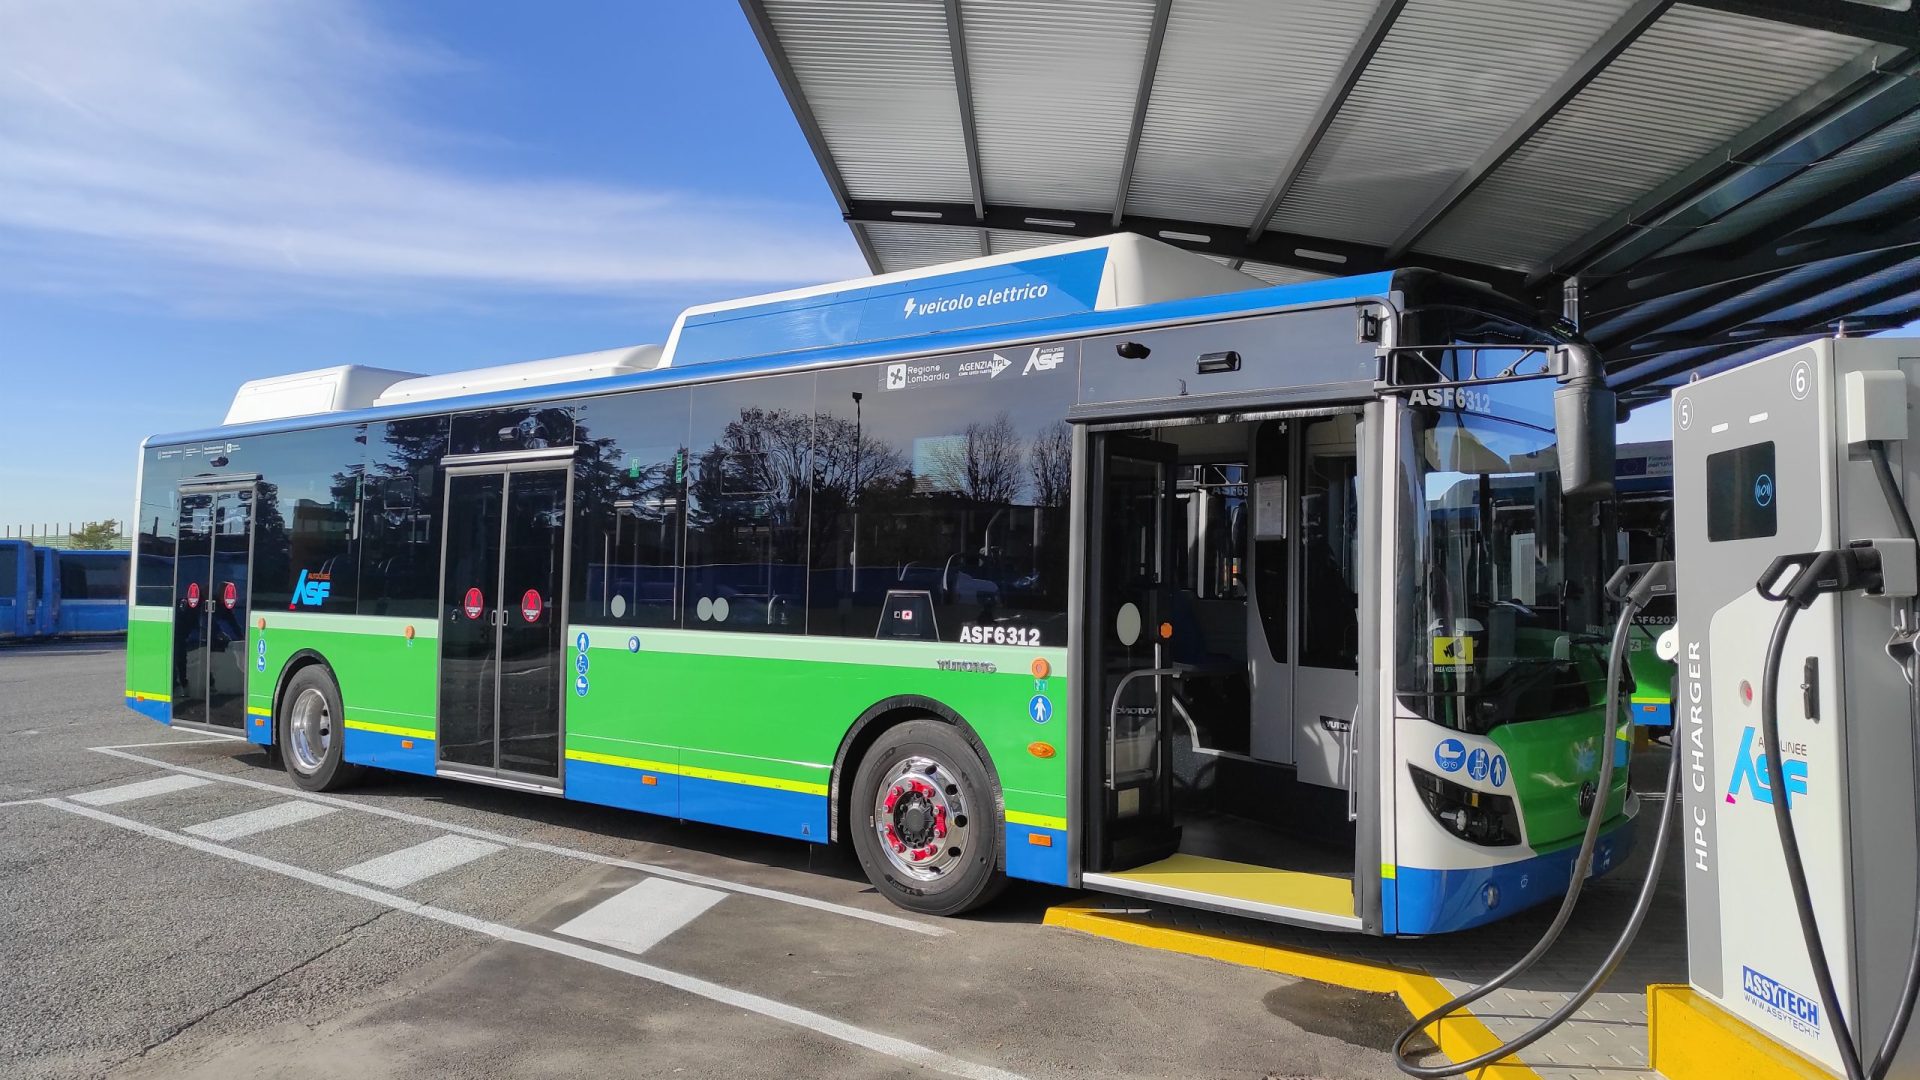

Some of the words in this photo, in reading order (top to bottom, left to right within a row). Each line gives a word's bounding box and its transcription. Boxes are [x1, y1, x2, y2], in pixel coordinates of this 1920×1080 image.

[919, 293, 974, 316] veicolo
[977, 283, 1048, 307] elettrico
[907, 364, 941, 375] Regione
[1021, 347, 1065, 376] ASF
[907, 371, 950, 384] Lombardia
[1796, 368, 1806, 393] 6
[1408, 387, 1491, 413] ASF6312
[1682, 404, 1689, 425] 5
[289, 568, 331, 609] ASF
[959, 625, 1041, 647] ASF6312
[936, 659, 998, 675] YUTONG
[1325, 719, 1351, 730] YUTON
[1688, 641, 1706, 793] CHARGER
[1757, 736, 1808, 757] ALINEE
[1693, 805, 1708, 872] HPC
[1744, 968, 1820, 1027] ASSYTECH
[1743, 993, 1821, 1041] WWW.ASSYTECH.IT
